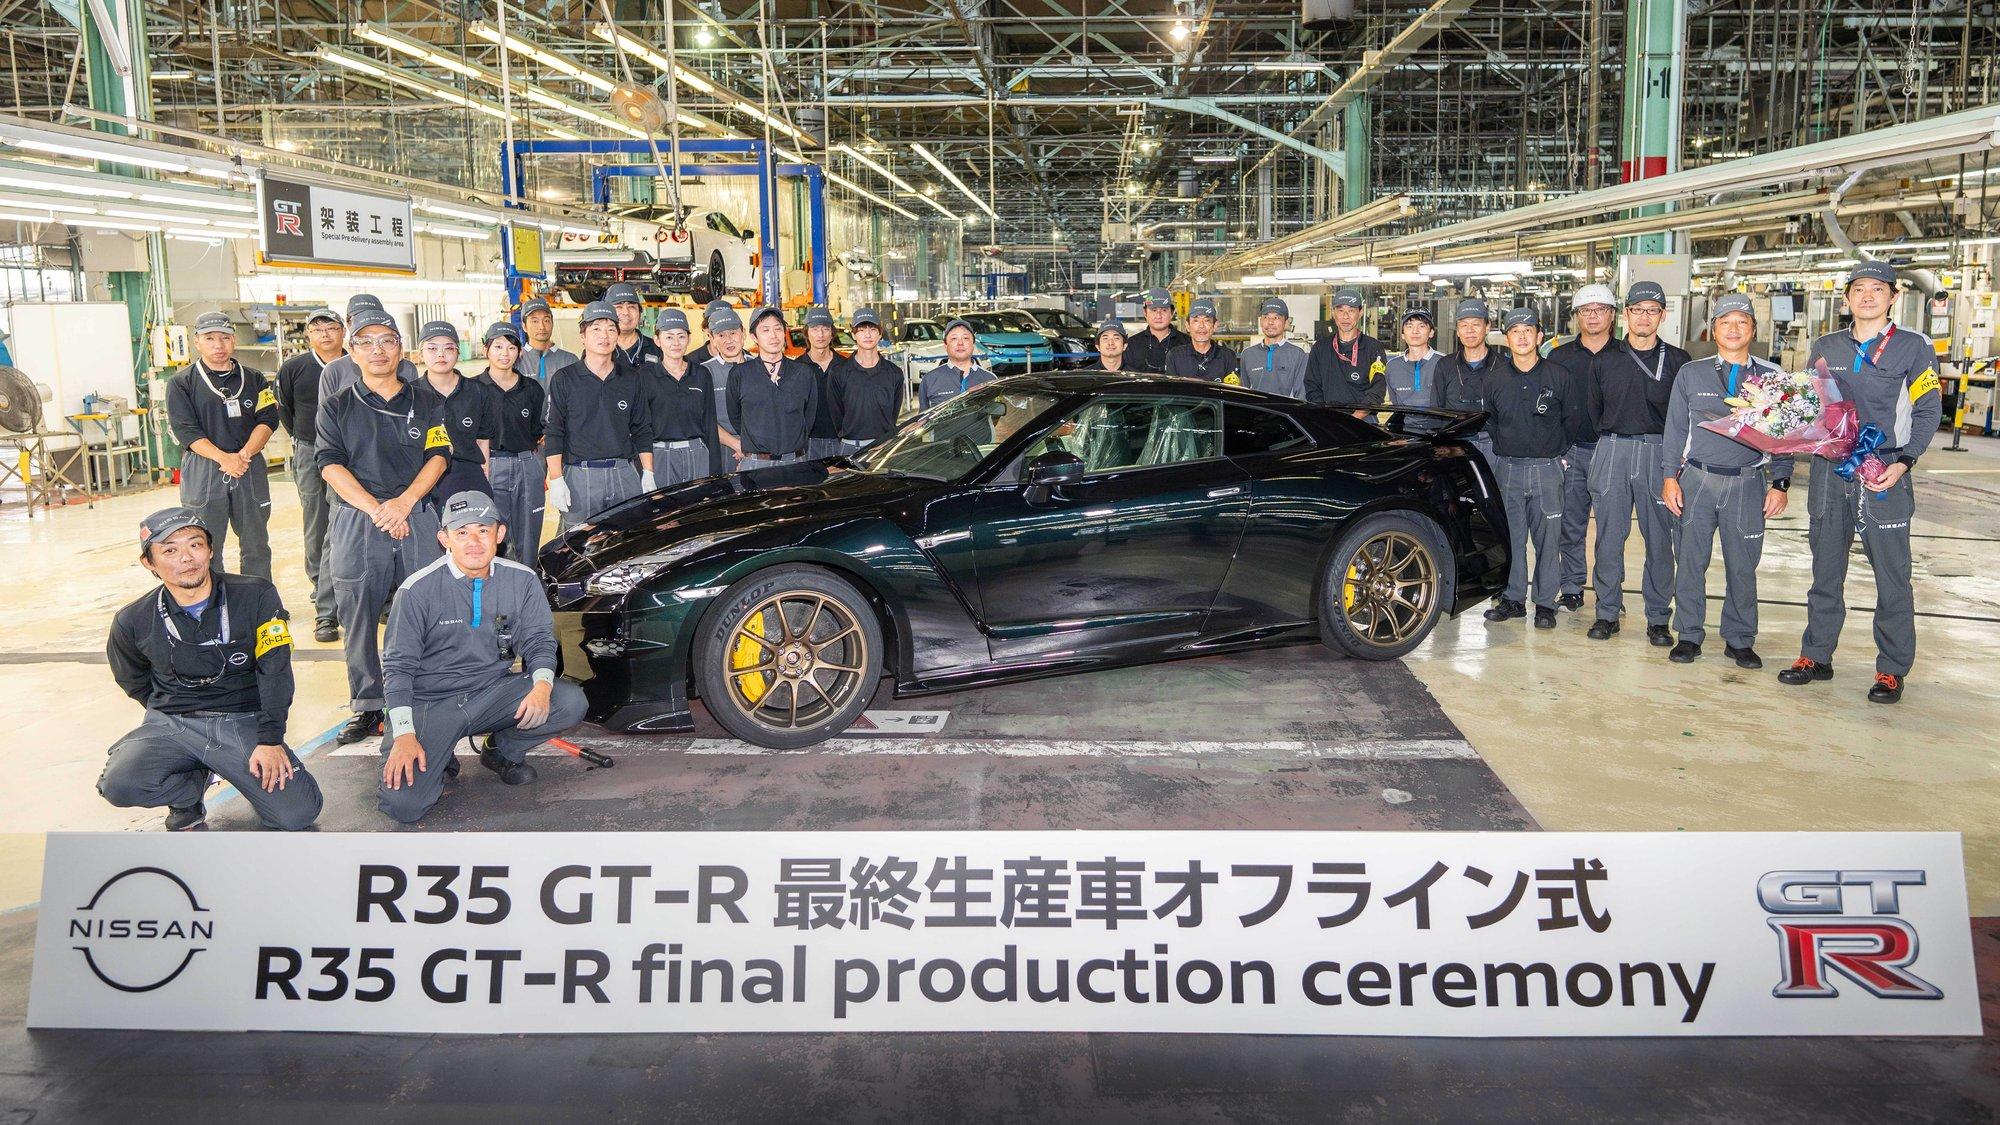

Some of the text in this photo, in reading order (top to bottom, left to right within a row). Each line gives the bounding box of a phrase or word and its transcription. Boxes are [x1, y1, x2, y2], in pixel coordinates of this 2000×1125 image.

[273, 199, 302, 214] GT
[276, 211, 304, 237] R
[320, 206, 404, 237] 架装工程
[321, 231, 341, 241] Special
[341, 234, 351, 242] Pre
[351, 235, 371, 246] delivery
[371, 238, 394, 248] assembly
[456, 507, 485, 515] NISSAN
[1878, 521, 1907, 529] NISSAN
[715, 581, 775, 643] DUNLOP
[357, 857, 1612, 933] R35 GT-R 最終生産車オフライン式
[1757, 870, 1926, 914] GT
[69, 919, 213, 940] NISSAN
[1766, 916, 1944, 1000] R
[255, 943, 1716, 1024] R35 GT-R final production ceremony
